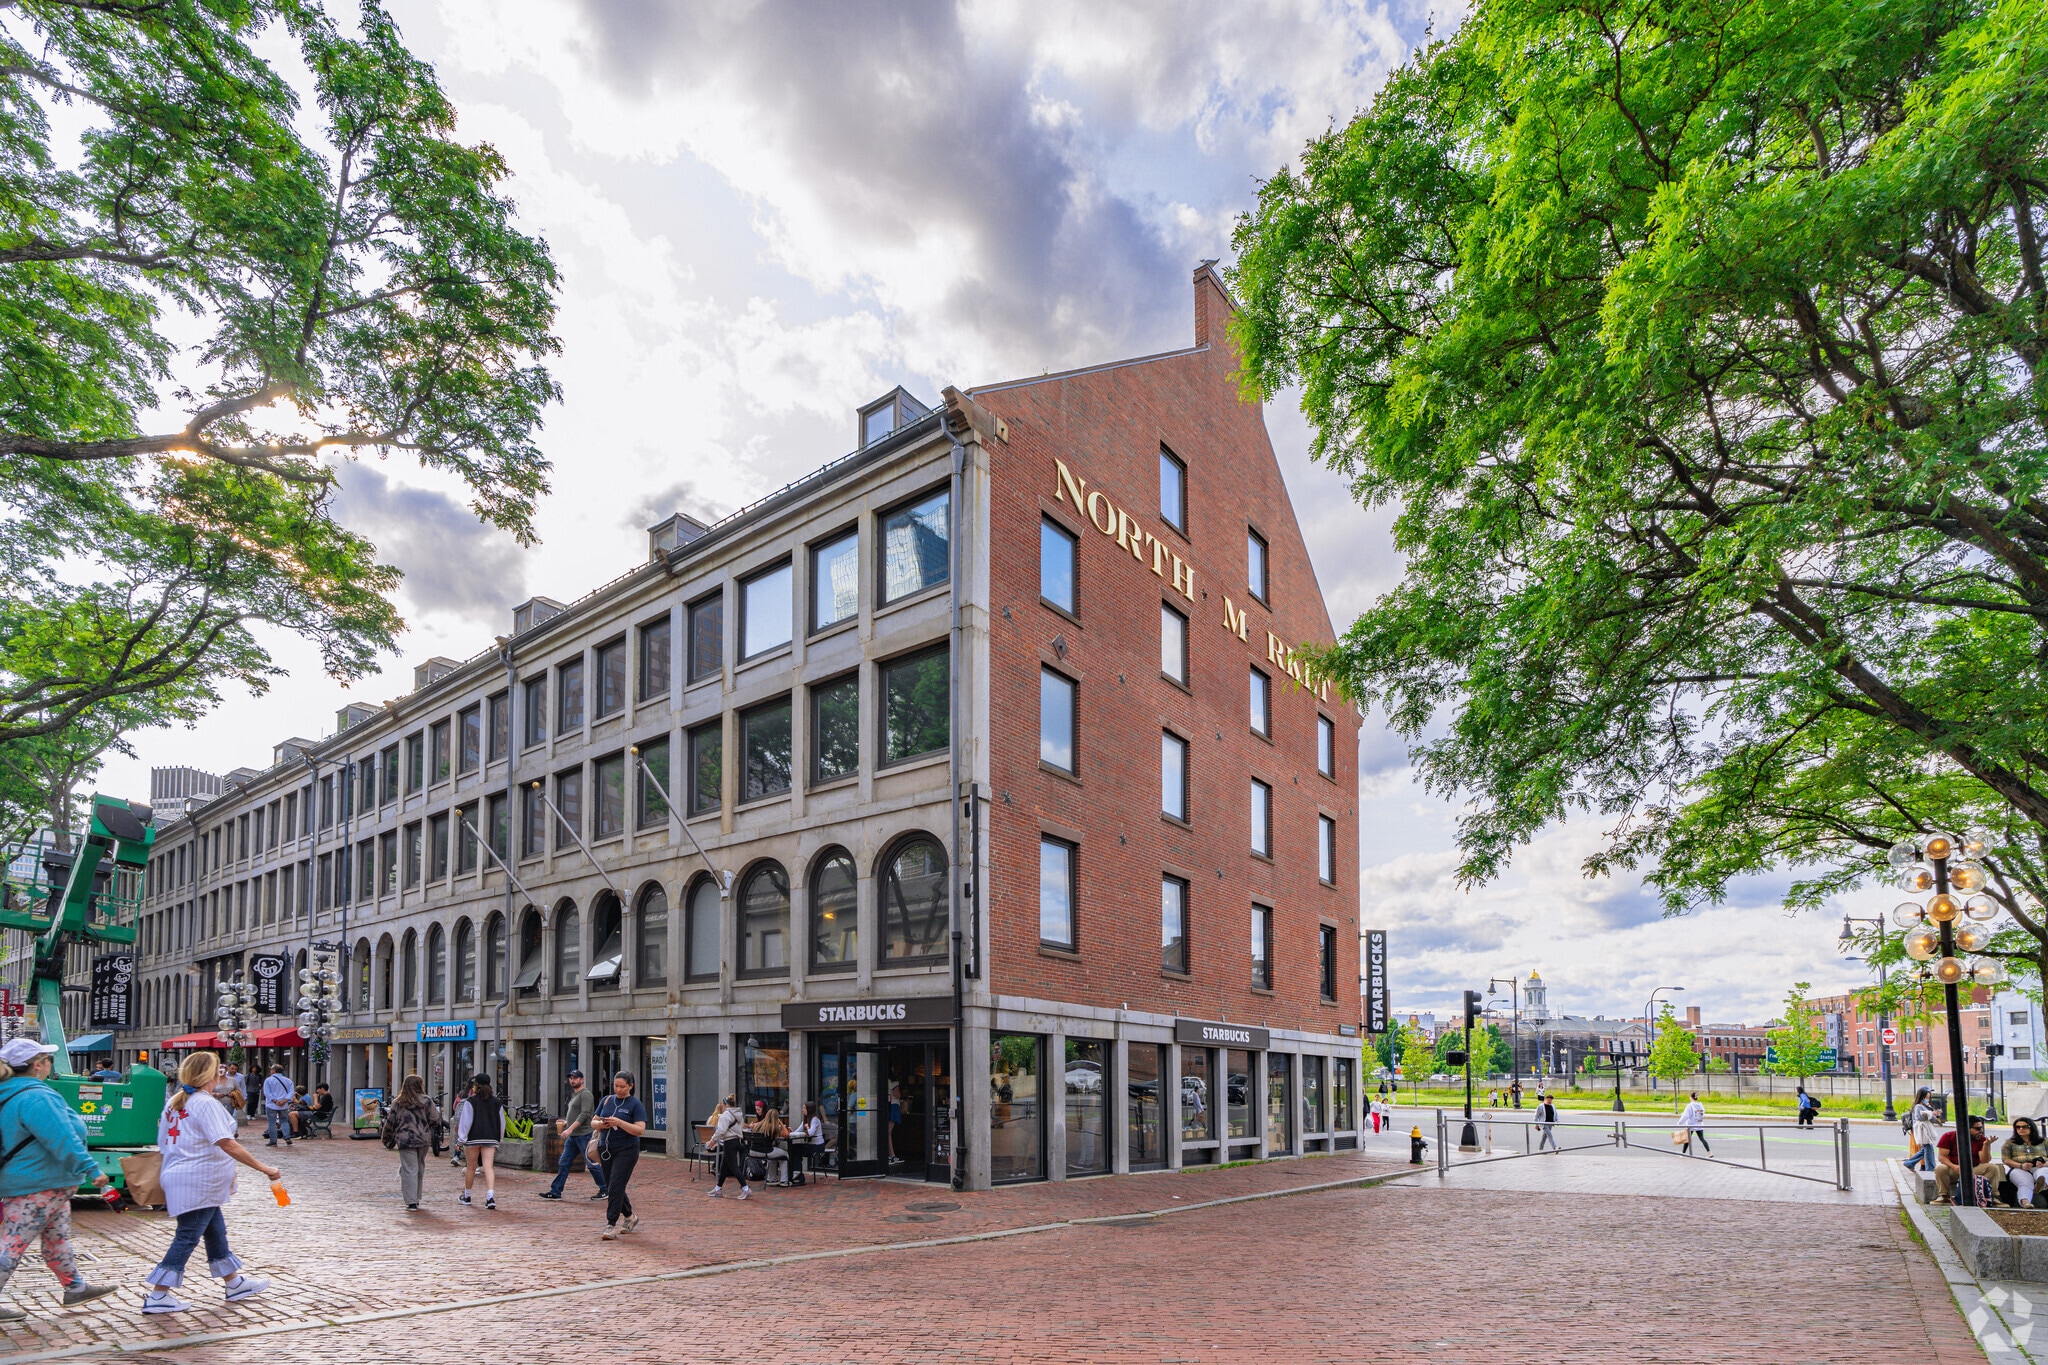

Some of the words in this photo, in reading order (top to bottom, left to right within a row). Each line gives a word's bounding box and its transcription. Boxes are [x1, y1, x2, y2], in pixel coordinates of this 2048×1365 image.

[1053, 457, 1196, 603] NORTH
[260, 978, 268, 1005] COMICS
[268, 979, 276, 1012] NEWBURY
[1371, 933, 1384, 1031] STARBUCKS
[110, 993, 118, 1018] COMICS
[118, 994, 127, 1025] NEWBURY
[819, 1004, 906, 1022] STARBUCKS
[355, 1028, 386, 1038] BUILDING
[1202, 1026, 1250, 1043] STARBUCKS
